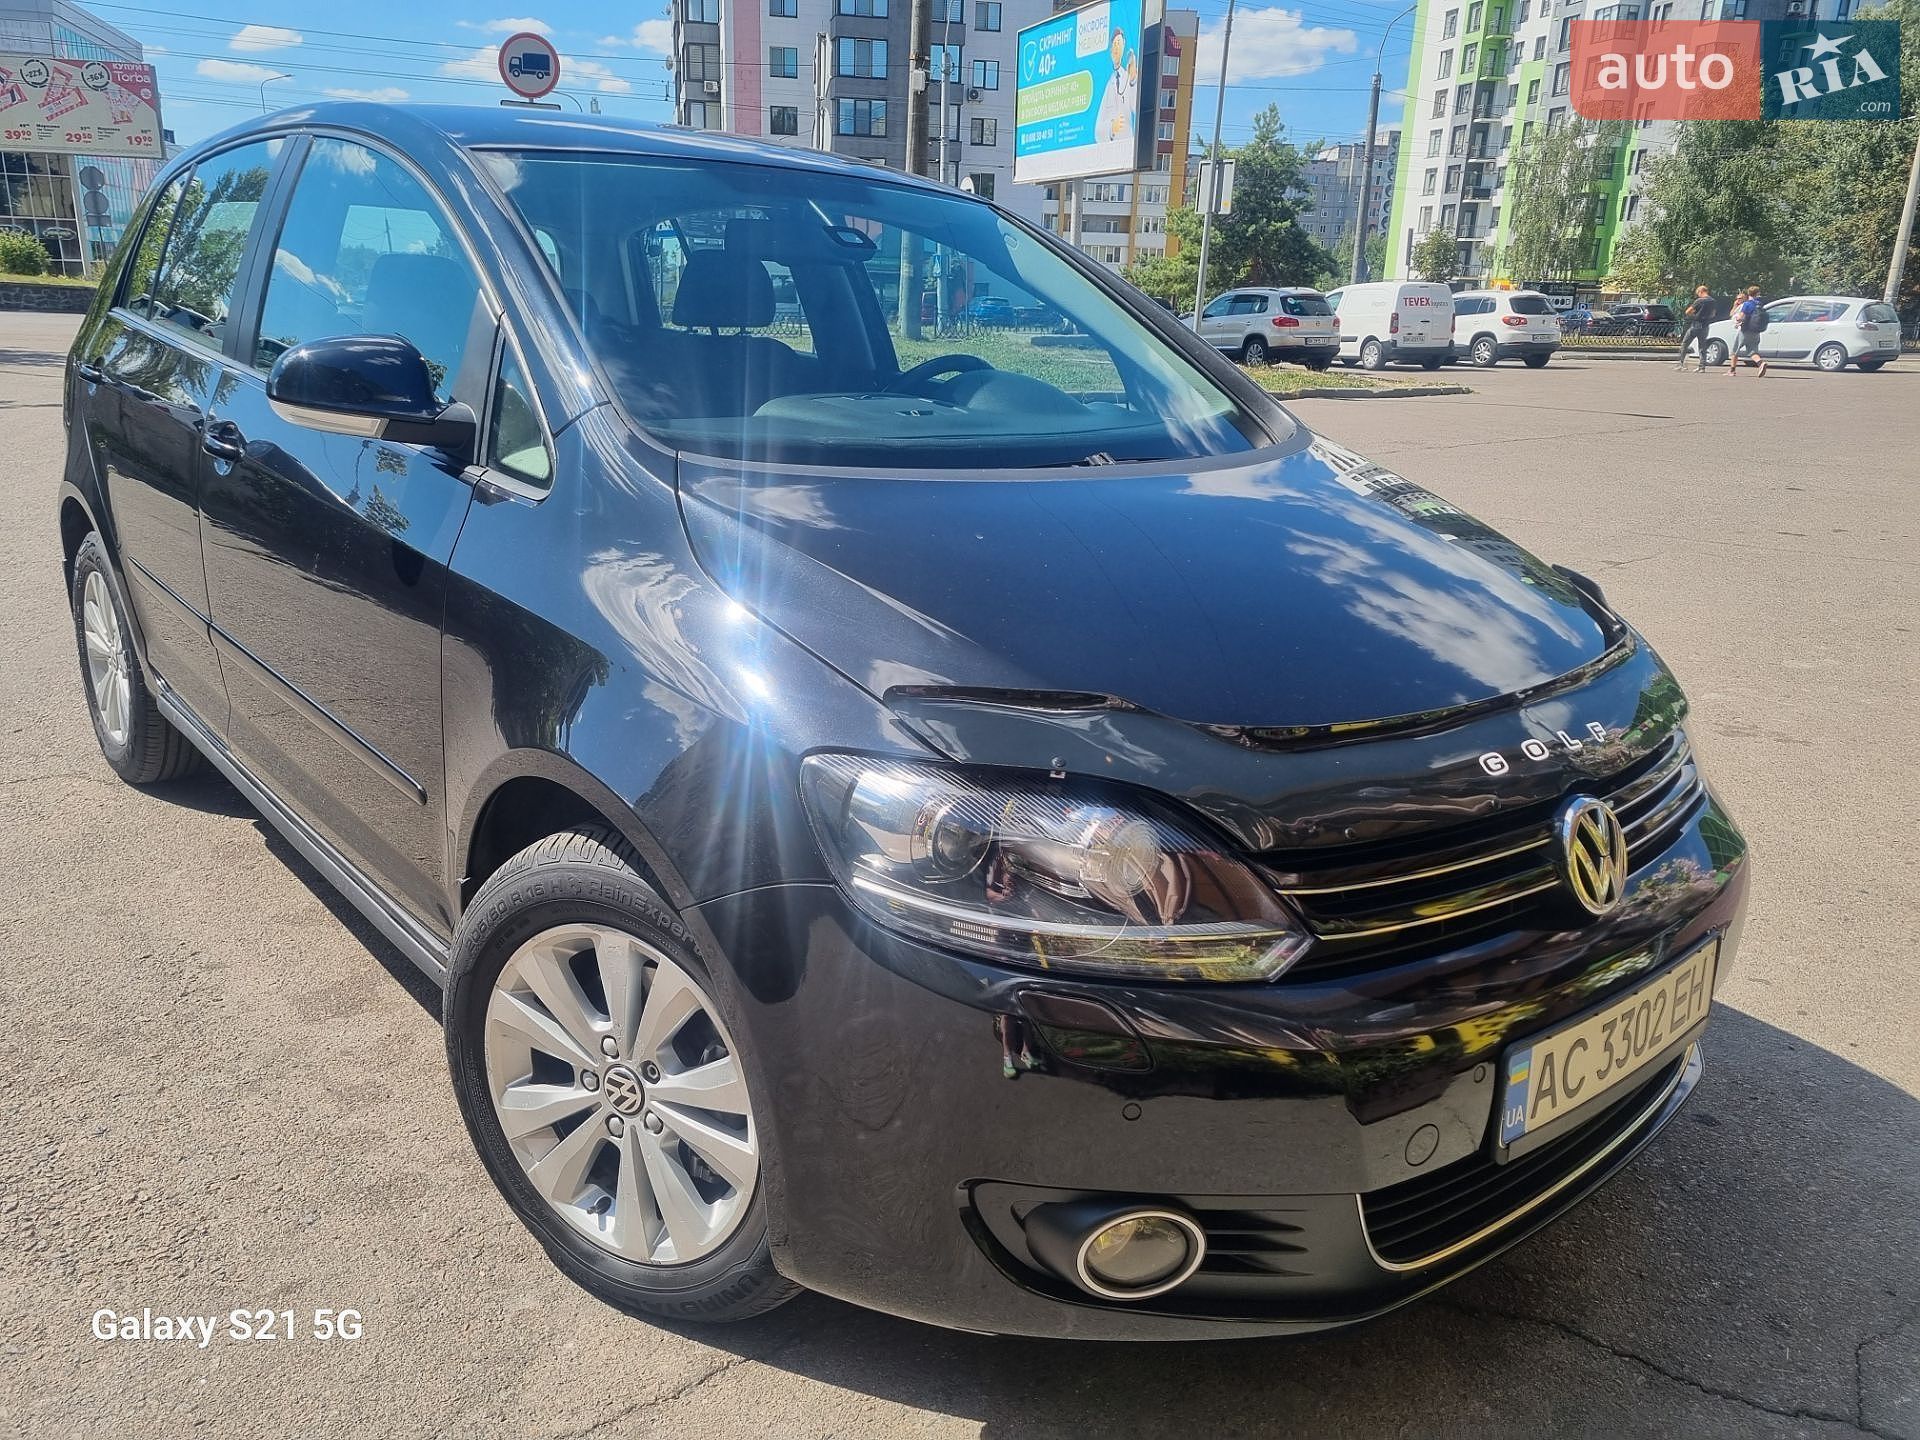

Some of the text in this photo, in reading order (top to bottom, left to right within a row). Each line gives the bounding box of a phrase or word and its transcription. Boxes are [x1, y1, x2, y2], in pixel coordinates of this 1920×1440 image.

[1039, 27, 1073, 52] СКРИНІНГ
[113, 71, 152, 83] Torba
[1038, 53, 1056, 77] 40+
[1403, 297, 1431, 307] TEVEX
[1478, 721, 1607, 777] GOLF
[1596, 990, 1669, 1080] 3302
[1505, 1106, 1525, 1129] UA
